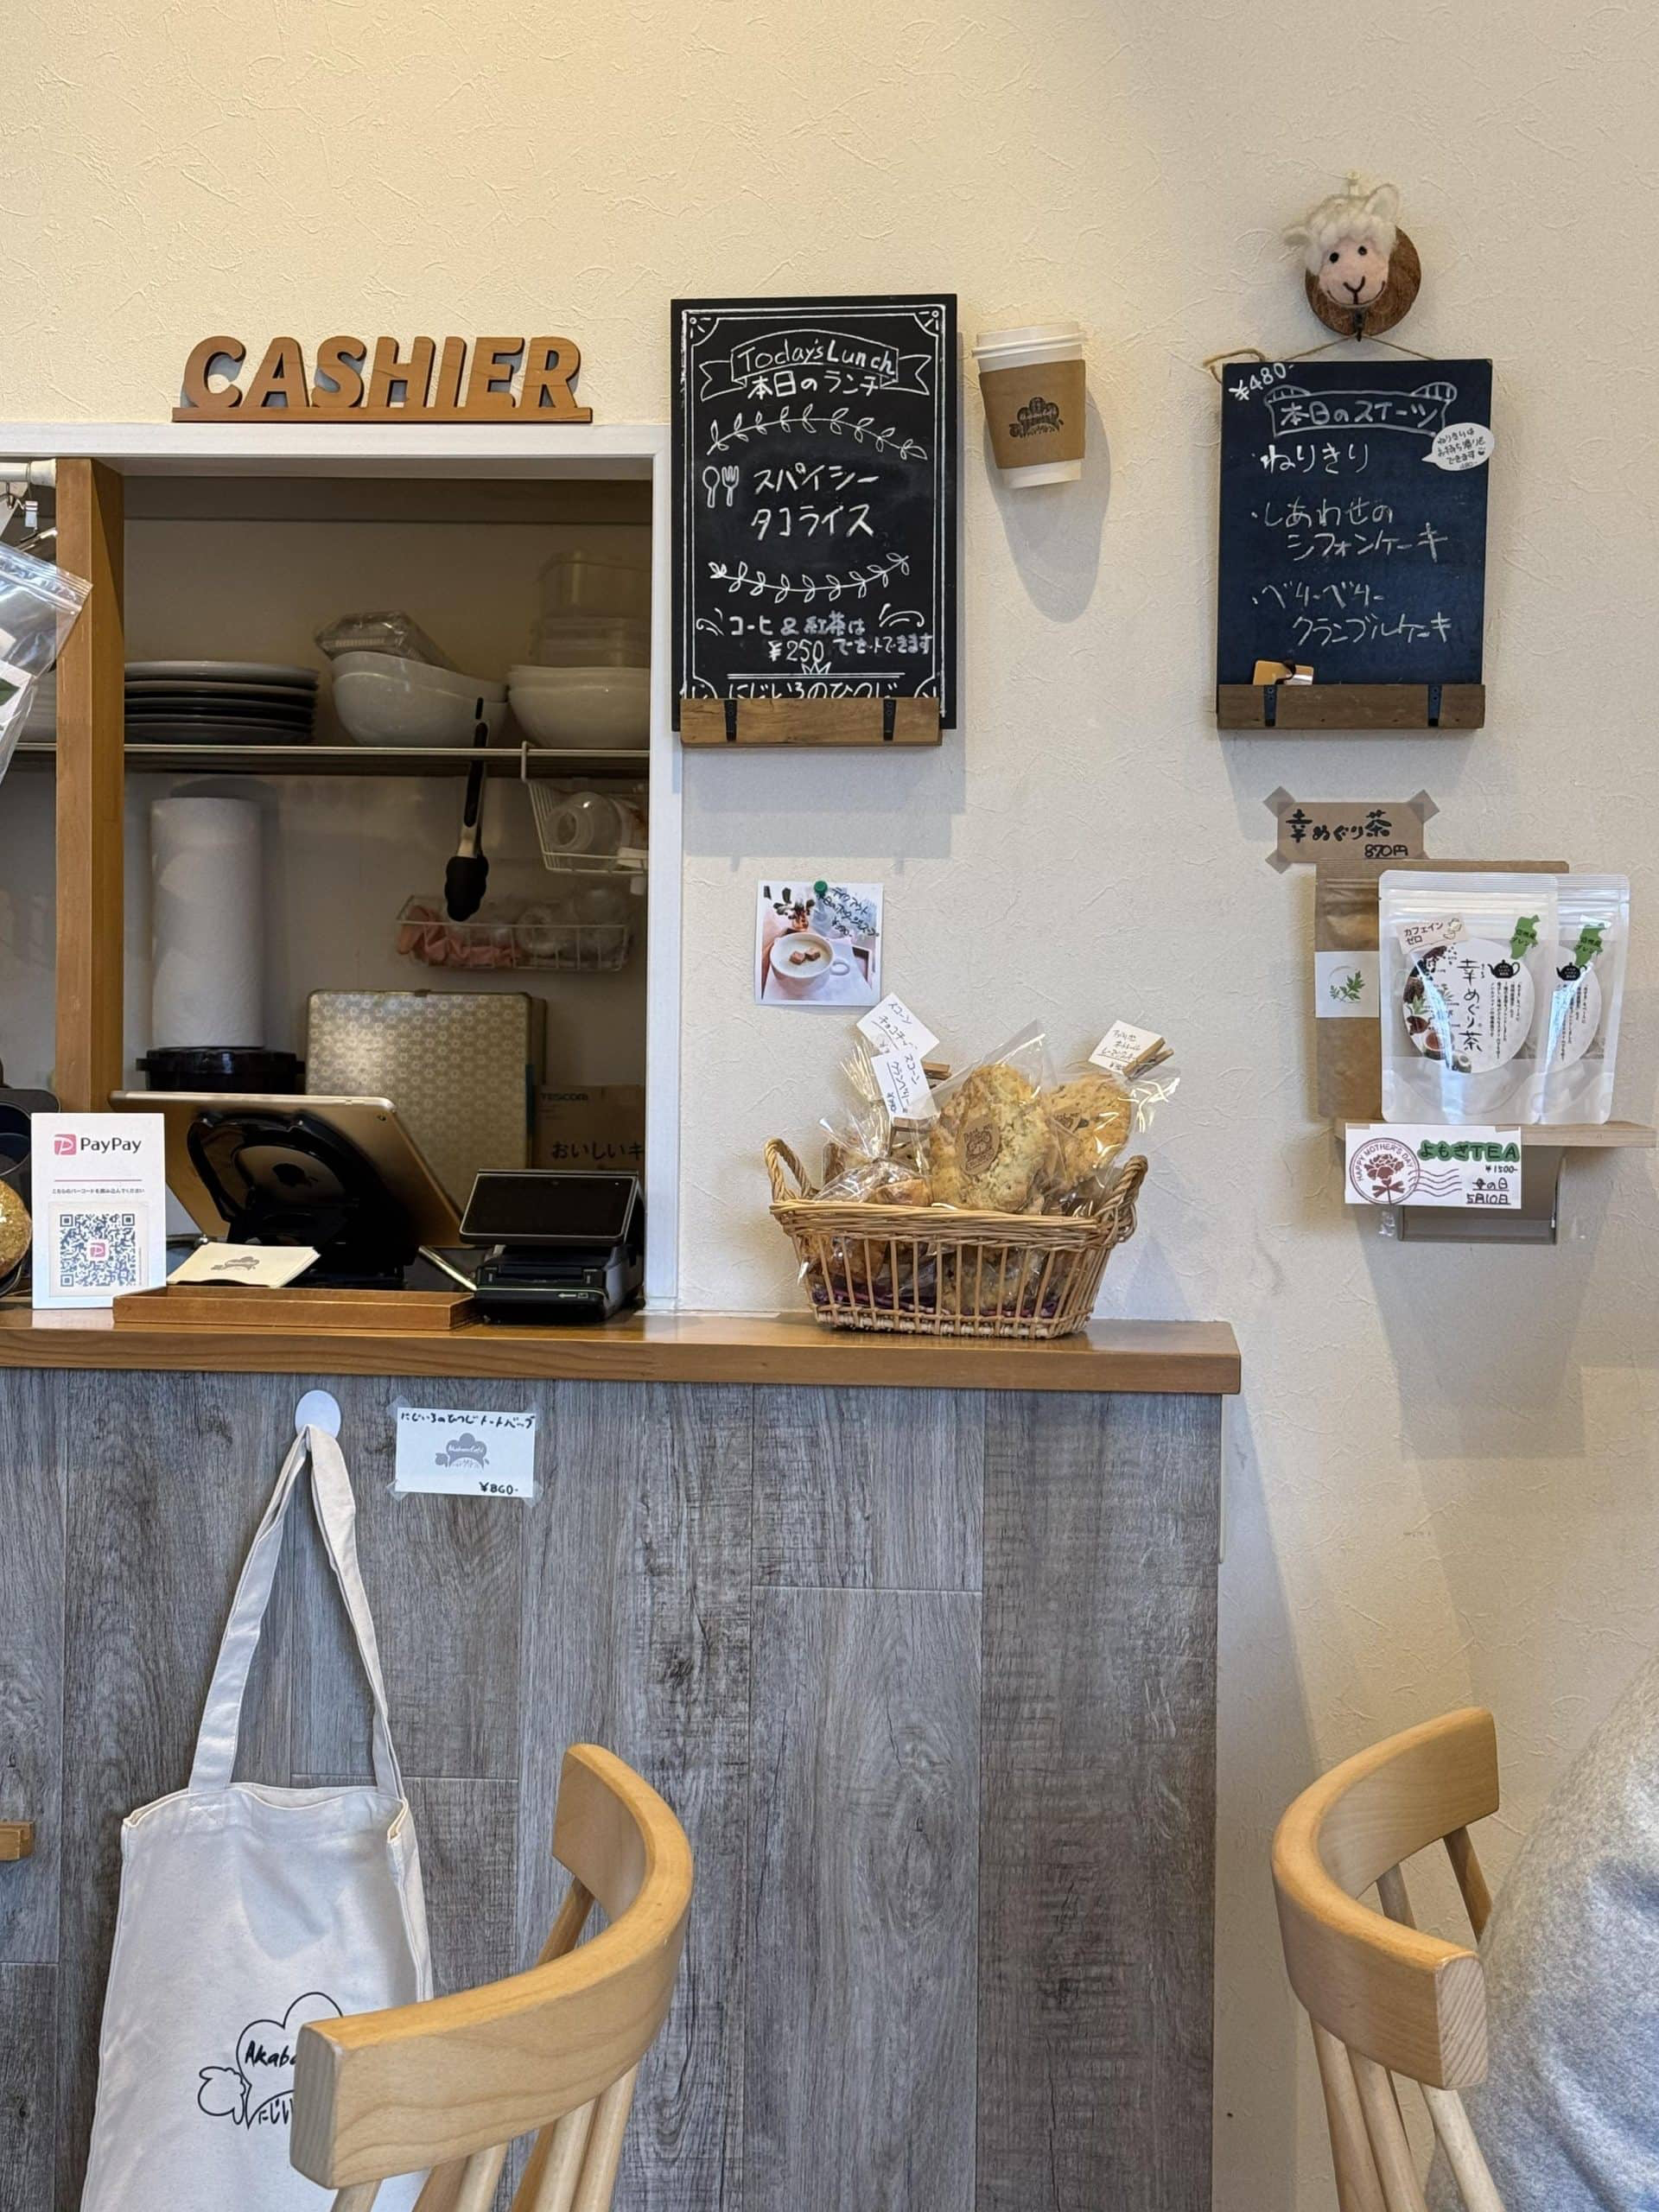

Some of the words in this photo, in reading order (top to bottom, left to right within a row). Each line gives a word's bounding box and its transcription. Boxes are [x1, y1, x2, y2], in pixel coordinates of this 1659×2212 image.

[181, 335, 582, 408] CASHIER
[737, 339, 823, 372] Today's
[826, 340, 895, 375] Lunch
[747, 370, 879, 399] 本日のランチ
[1281, 401, 1438, 428] 本日のスイーツ
[1260, 442, 1369, 474] ねりきり
[753, 462, 880, 494] スパイシー
[751, 504, 874, 541] タコライス
[1264, 497, 1393, 528] しあわせの
[1287, 522, 1448, 563] シフォンケーキ
[1292, 612, 1452, 645] クランブルケーキ
[1286, 809, 1392, 843] 幸めぐり茶
[1364, 843, 1408, 858] 870円
[1403, 922, 1444, 938] カフェイン
[1406, 934, 1423, 946] ゼロ
[888, 1001, 913, 1026] スコーン
[1457, 958, 1483, 1052] 幸めぐり茶
[904, 1053, 920, 1084] スコーン
[80, 1137, 142, 1154] PayPay
[551, 1141, 645, 1160] おいしいキ
[1418, 1141, 1520, 1161] よもぎTEA
[1355, 1154, 1366, 1181] HAPPY
[1363, 1142, 1403, 1156] MOTHER'S
[1402, 1153, 1414, 1167] DAY
[1466, 1192, 1508, 1203] 5月10日
[1472, 1177, 1508, 1190] 母の日
